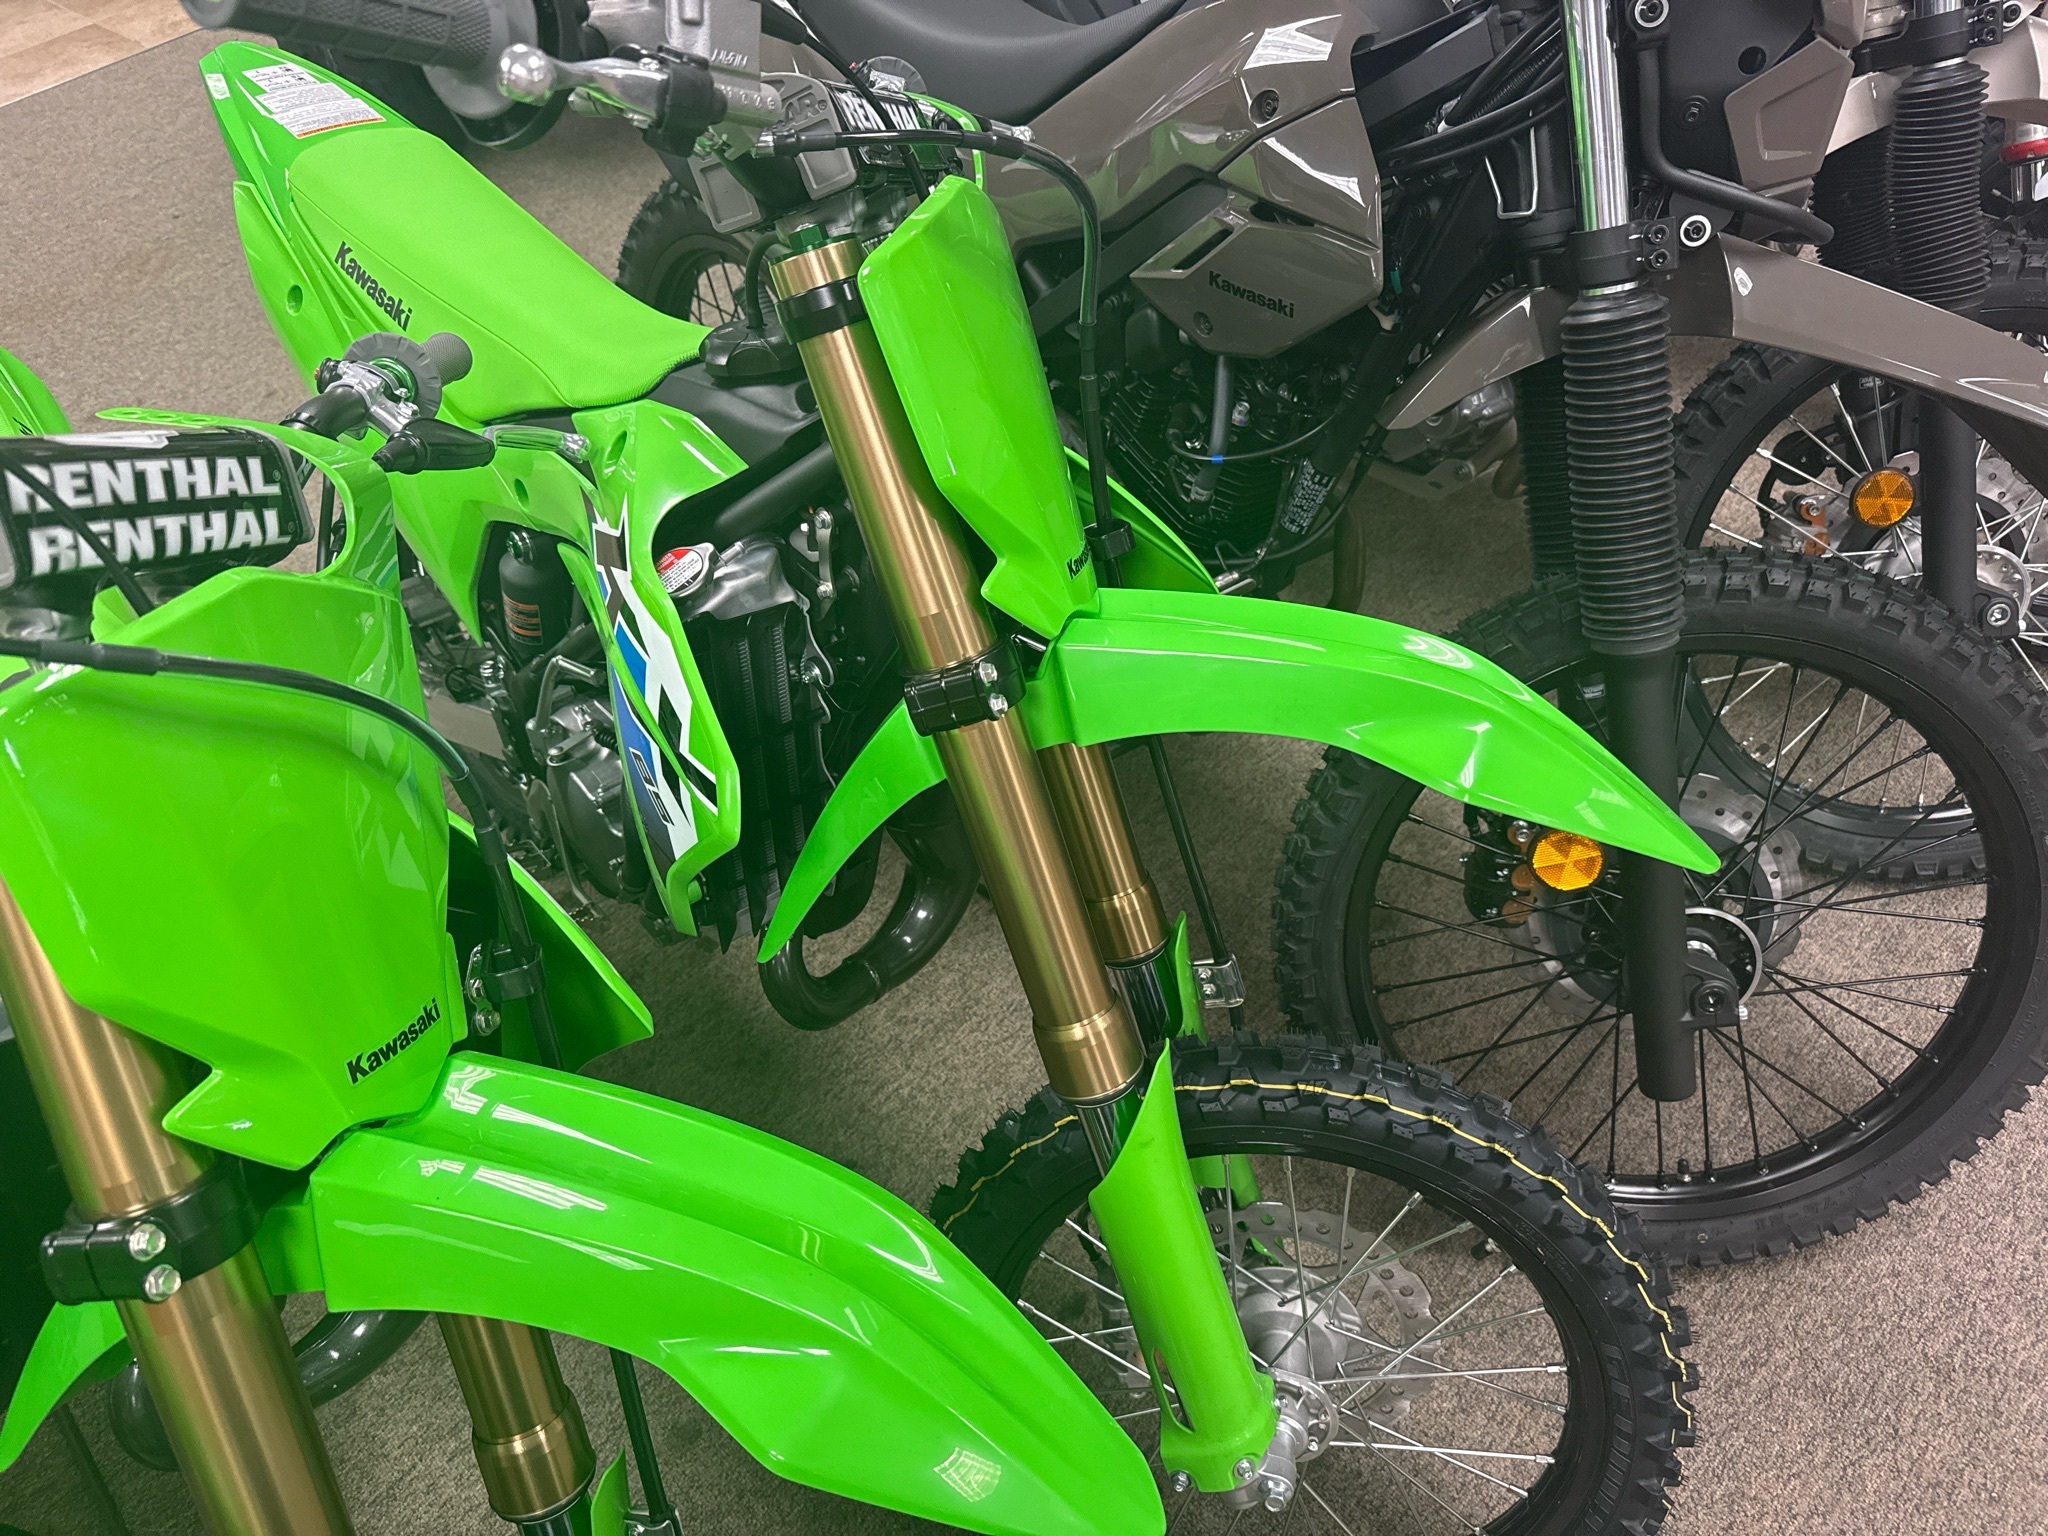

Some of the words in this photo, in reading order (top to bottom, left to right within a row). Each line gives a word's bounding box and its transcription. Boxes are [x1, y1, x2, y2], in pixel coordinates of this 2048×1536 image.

[334, 240, 413, 332] Kawasaki
[1208, 270, 1295, 319] Kawasaki
[346, 997, 441, 1085] Kawasaki
